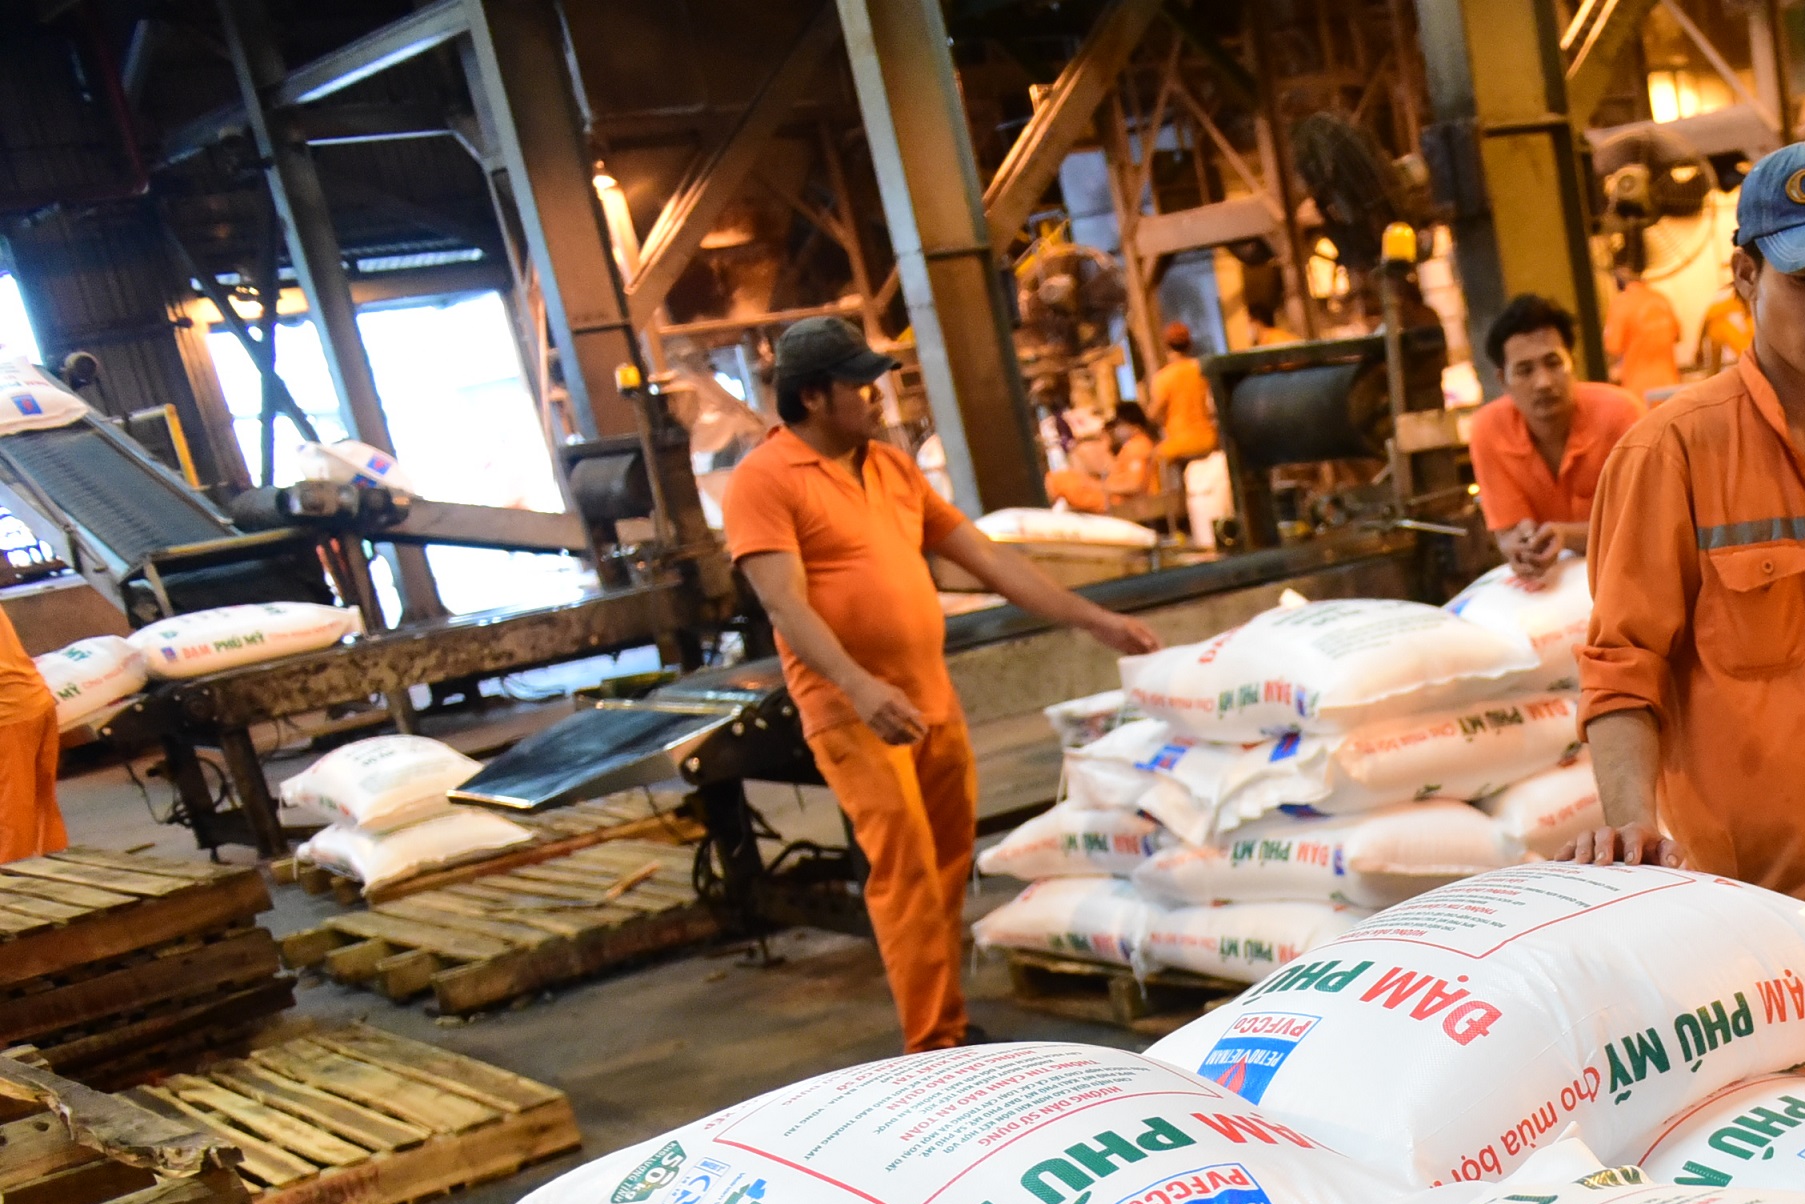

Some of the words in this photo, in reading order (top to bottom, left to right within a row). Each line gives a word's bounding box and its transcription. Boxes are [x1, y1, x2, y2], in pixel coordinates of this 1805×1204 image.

[1242, 960, 1375, 1006] PHÚ
[1233, 1016, 1312, 1039] PVFCCo
[1360, 966, 1503, 1046] ĐẠM
[1674, 992, 1755, 1072] PHÚ
[1204, 1047, 1282, 1069] PETROVIETNAM
[1604, 1027, 1671, 1106] MỸ
[935, 1103, 958, 1118] AN
[1561, 1067, 1601, 1113] Cho
[977, 1121, 1021, 1147] DỤNG
[1191, 1113, 1345, 1158] ẠM
[1500, 1106, 1558, 1160] mùa
[644, 1149, 683, 1186] 50
